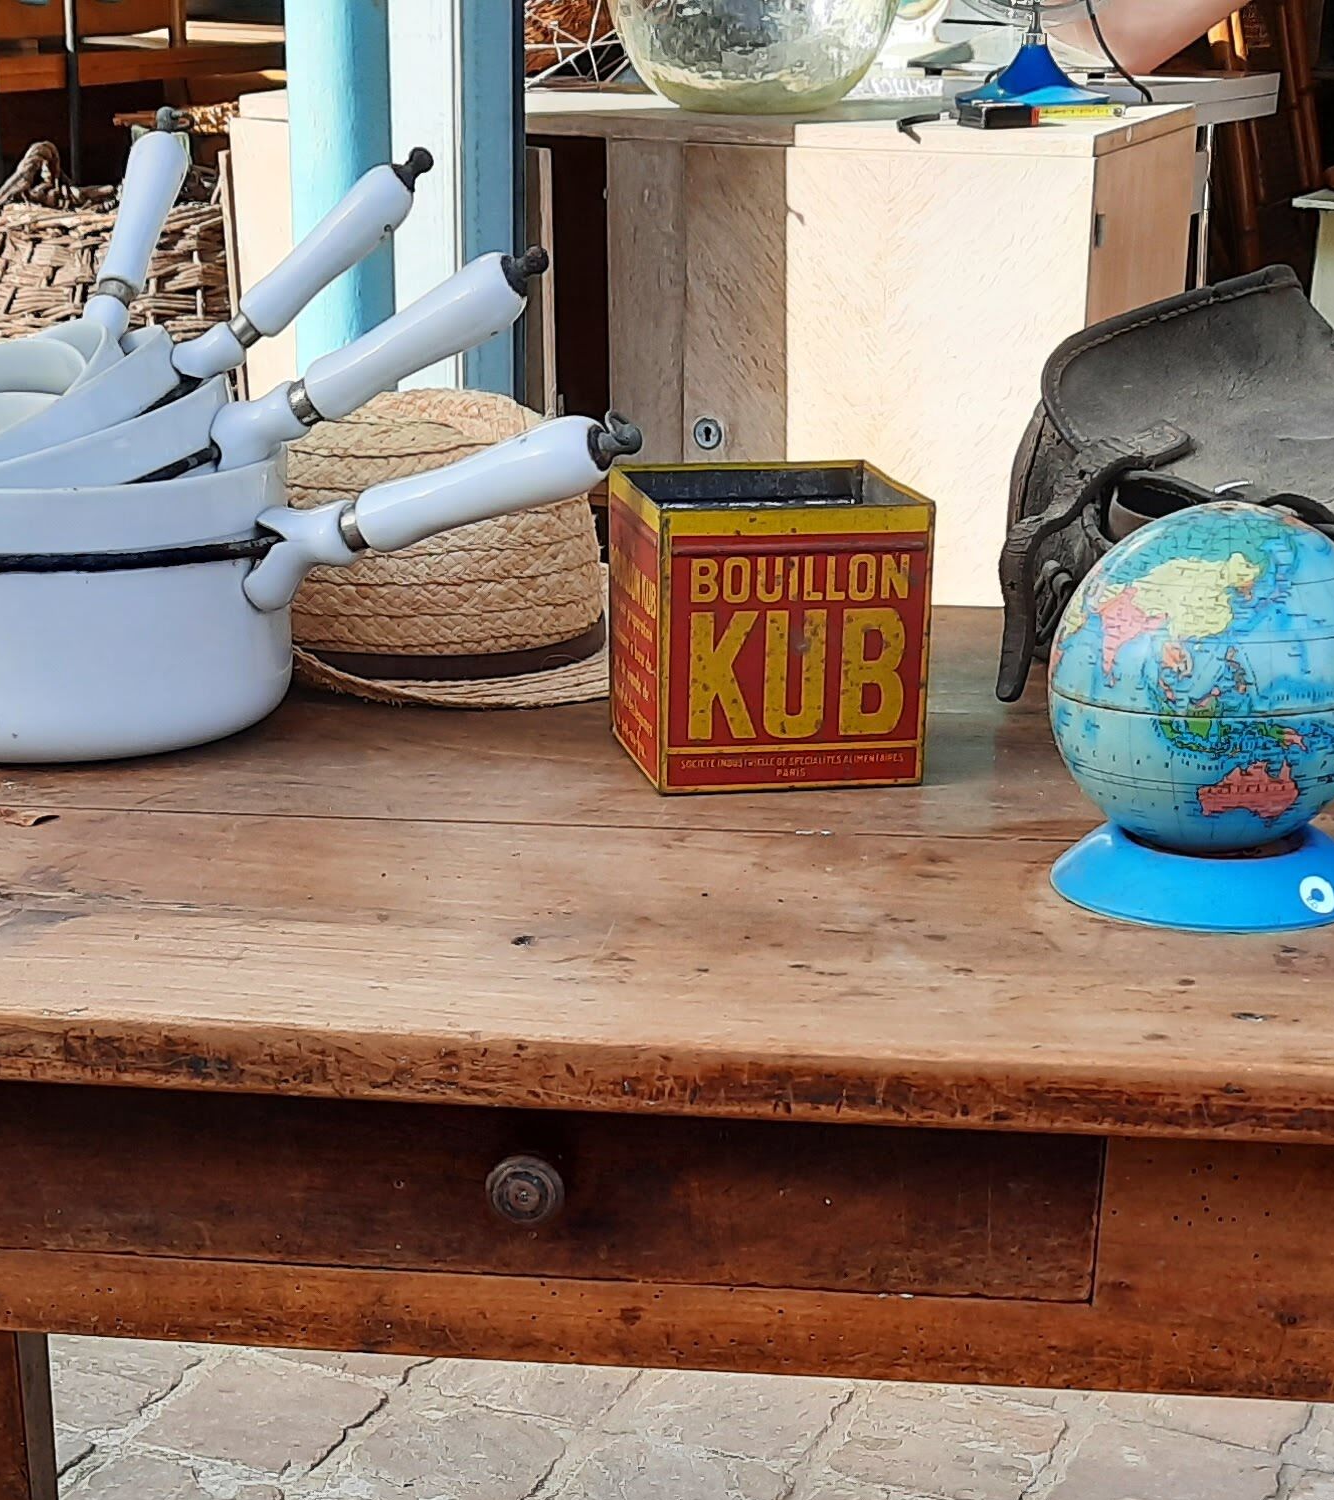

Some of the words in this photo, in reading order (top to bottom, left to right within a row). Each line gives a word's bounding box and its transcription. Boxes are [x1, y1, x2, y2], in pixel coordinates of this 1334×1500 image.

[690, 554, 909, 603] BOUILLON
[688, 608, 905, 740] KUB
[775, 767, 807, 777] PARIS
